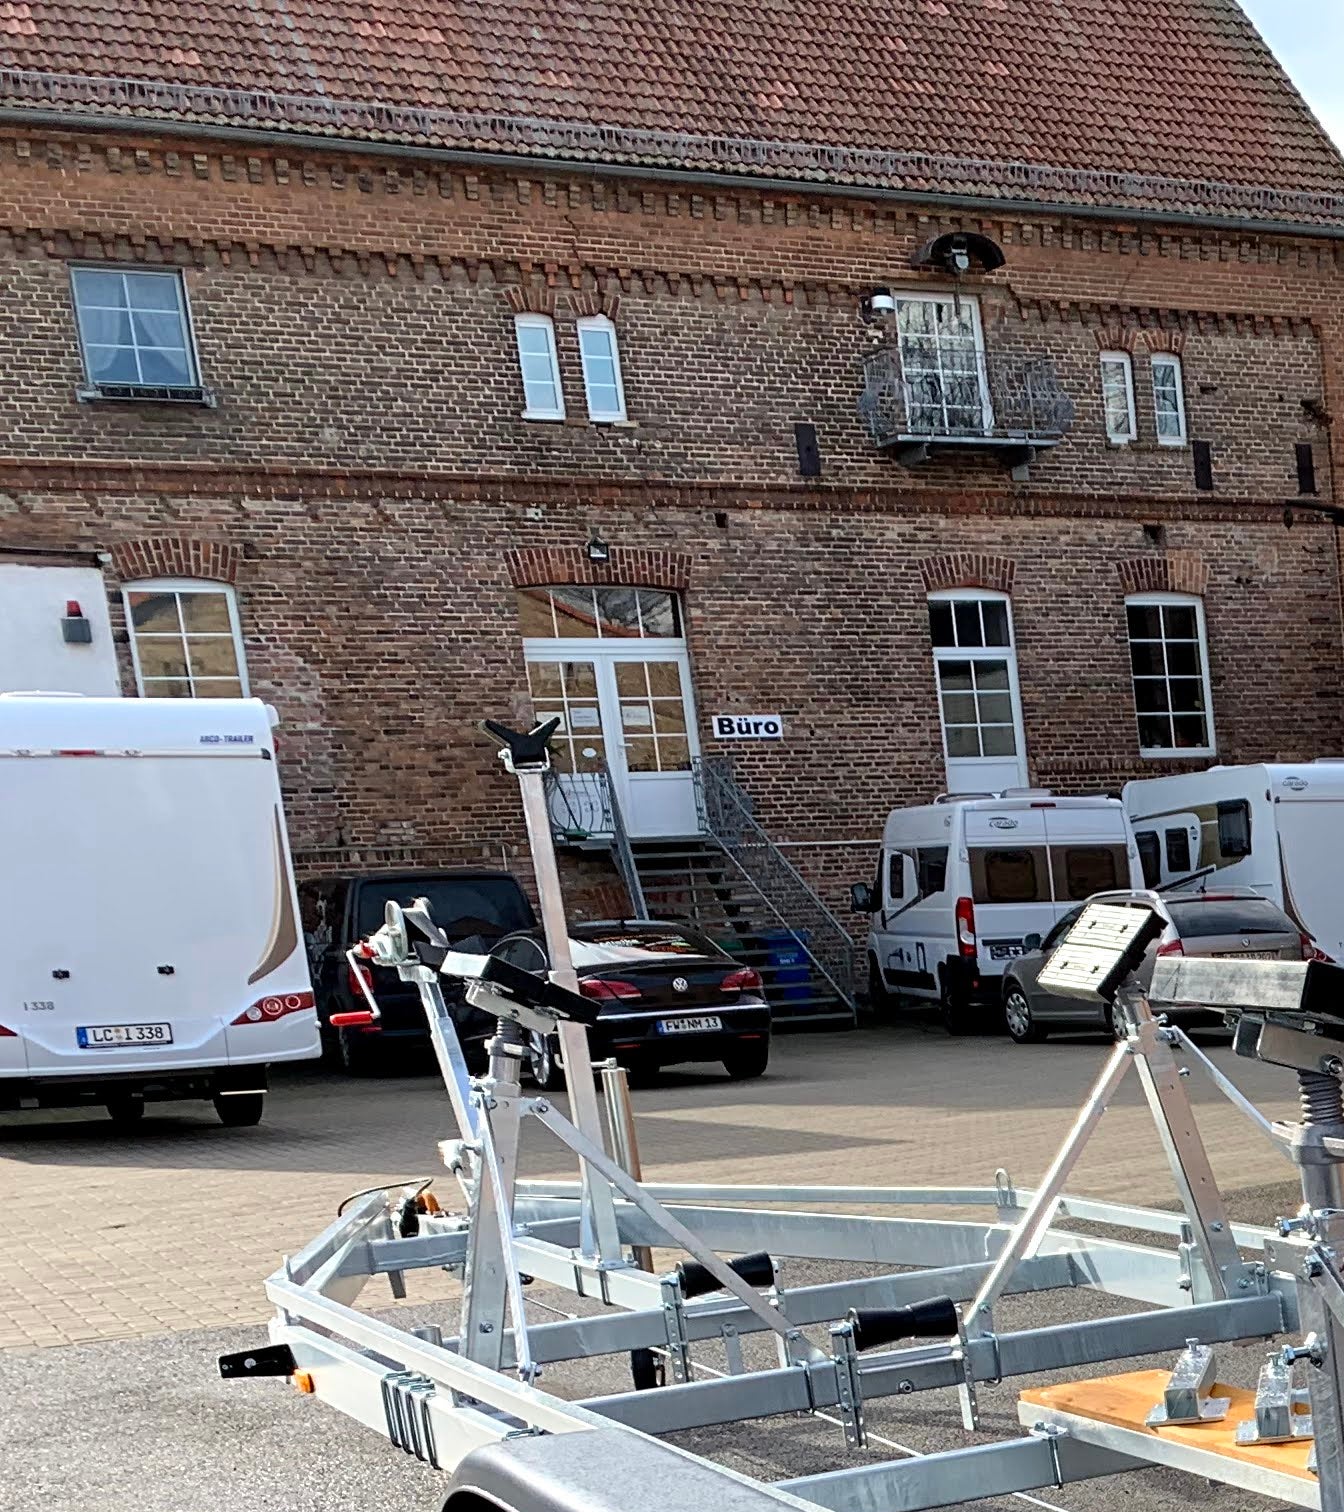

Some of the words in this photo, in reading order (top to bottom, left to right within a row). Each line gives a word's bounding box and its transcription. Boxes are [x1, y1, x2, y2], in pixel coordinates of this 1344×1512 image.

[717, 717, 779, 735] Büro
[32, 1001, 55, 1011] 338
[687, 1019, 702, 1029] NM
[705, 1017, 719, 1028] 13
[92, 1028, 114, 1042] LC
[136, 1026, 164, 1040] 338
